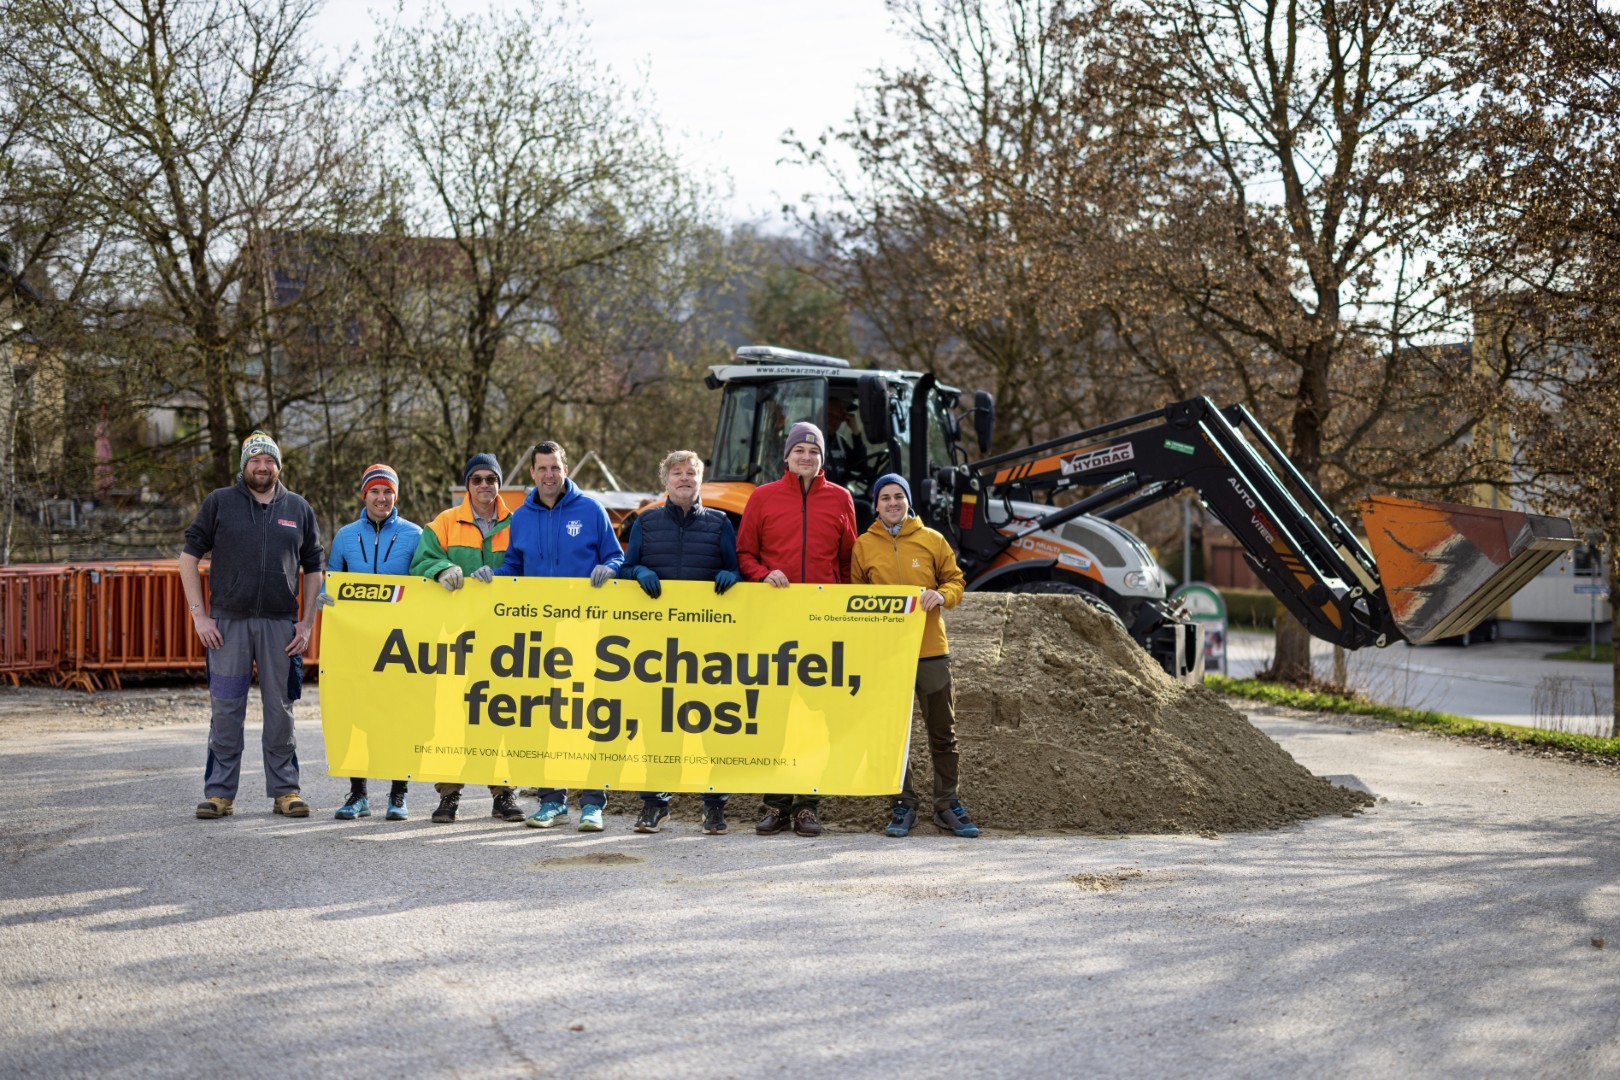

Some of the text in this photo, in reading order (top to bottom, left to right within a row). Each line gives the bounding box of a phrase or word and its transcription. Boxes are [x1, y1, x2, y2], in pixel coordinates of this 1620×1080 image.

[756, 365, 840, 376] www.schwarzmayr.at
[1073, 450, 1130, 471] HYDRAC
[341, 582, 392, 600] öaab
[493, 602, 737, 624] Gratis Sand für unsere Familien.
[850, 594, 904, 613] oövp
[809, 614, 905, 623] Die Oberösterreich-Partei
[373, 628, 862, 697] Auf die Schaufel,
[464, 680, 760, 742] fertig, los!
[414, 744, 433, 754] EINE
[435, 746, 478, 756] INITIATIVE
[479, 748, 499, 757] VON
[500, 749, 597, 761] LANDESHAUPTMANN
[599, 752, 640, 763] THOMAS
[641, 754, 681, 764] STELZER
[683, 754, 709, 765] FÜRS
[710, 756, 771, 767] KINDERLAND
[773, 757, 789, 767] NR.
